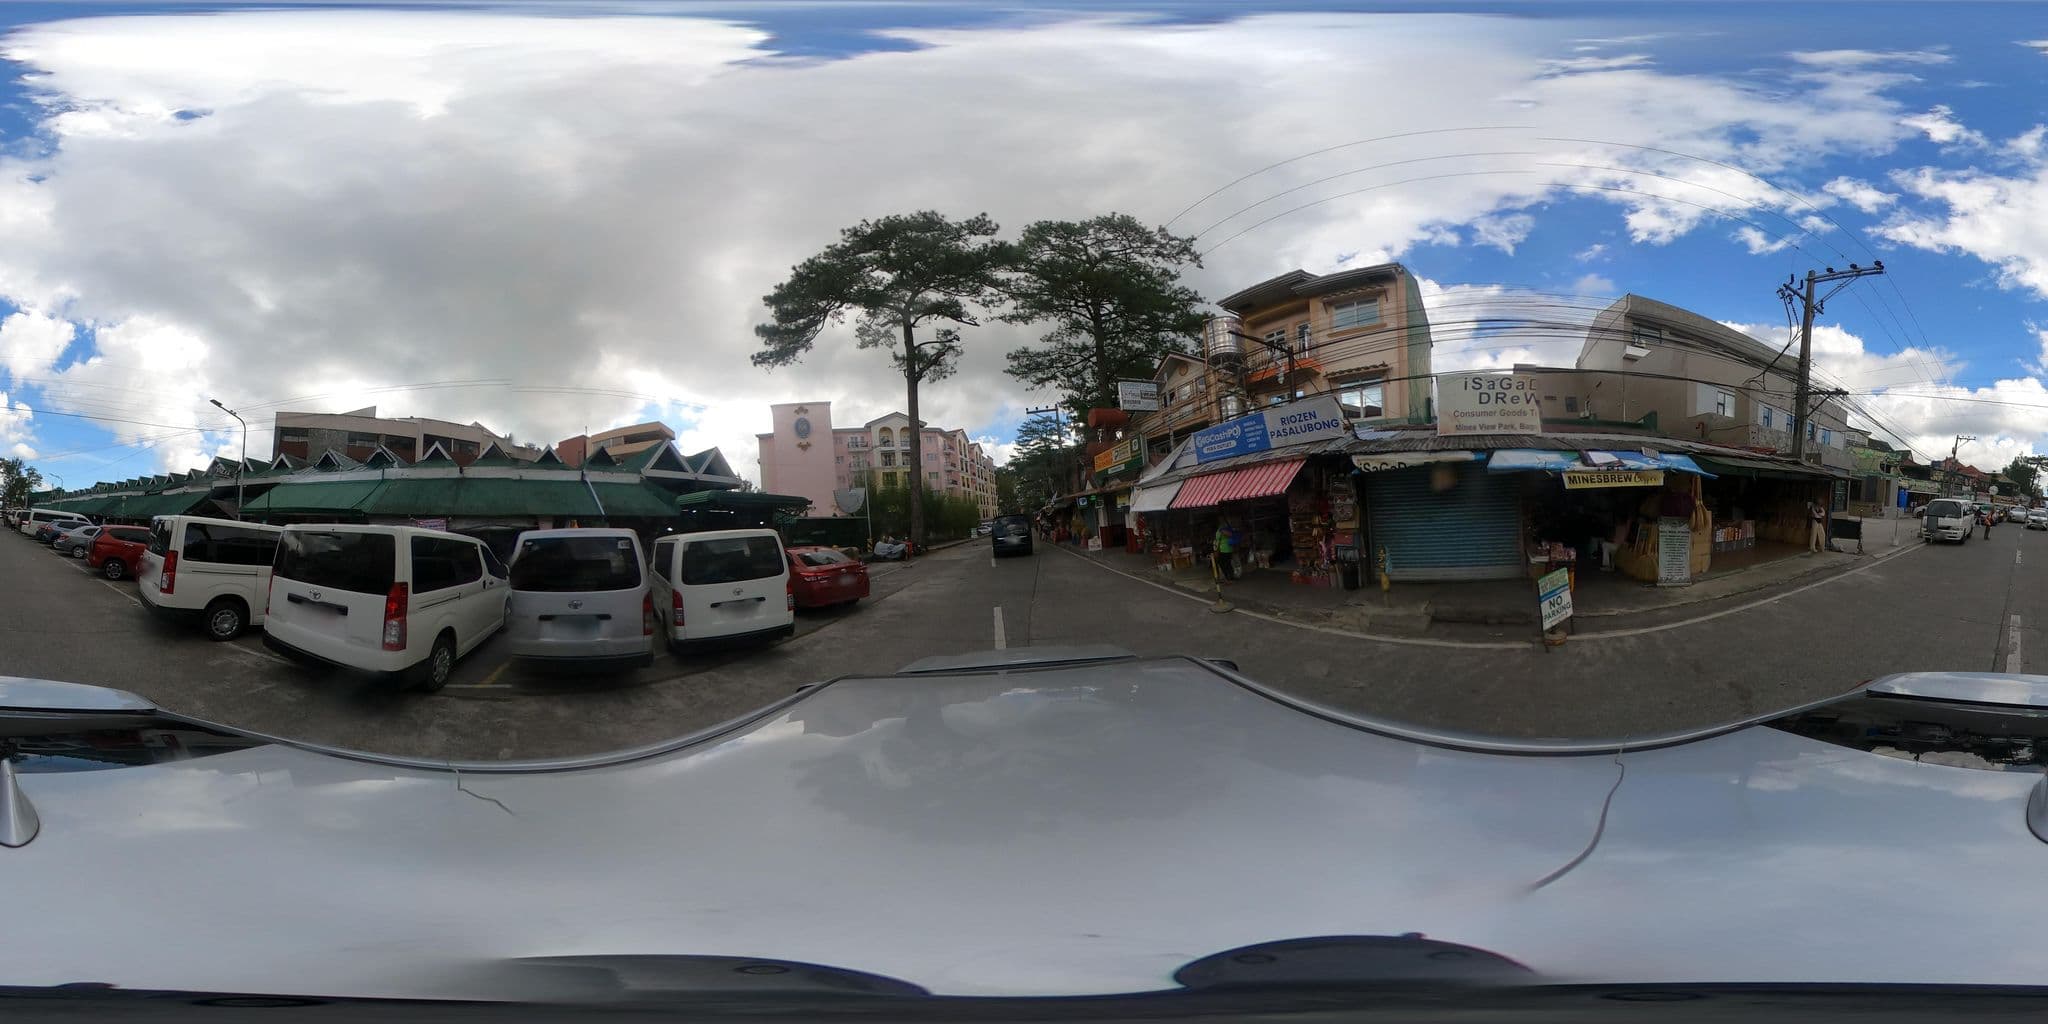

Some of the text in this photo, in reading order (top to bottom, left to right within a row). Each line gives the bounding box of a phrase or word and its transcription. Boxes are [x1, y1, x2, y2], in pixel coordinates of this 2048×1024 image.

[1280, 410, 1317, 426] RIOZEN
[1453, 410, 1496, 418] Consumer
[1500, 409, 1528, 417] Goods
[1270, 418, 1339, 439] PASALUBONG
[1567, 474, 1633, 485] MINESBREW
[1549, 595, 1563, 610] NO
